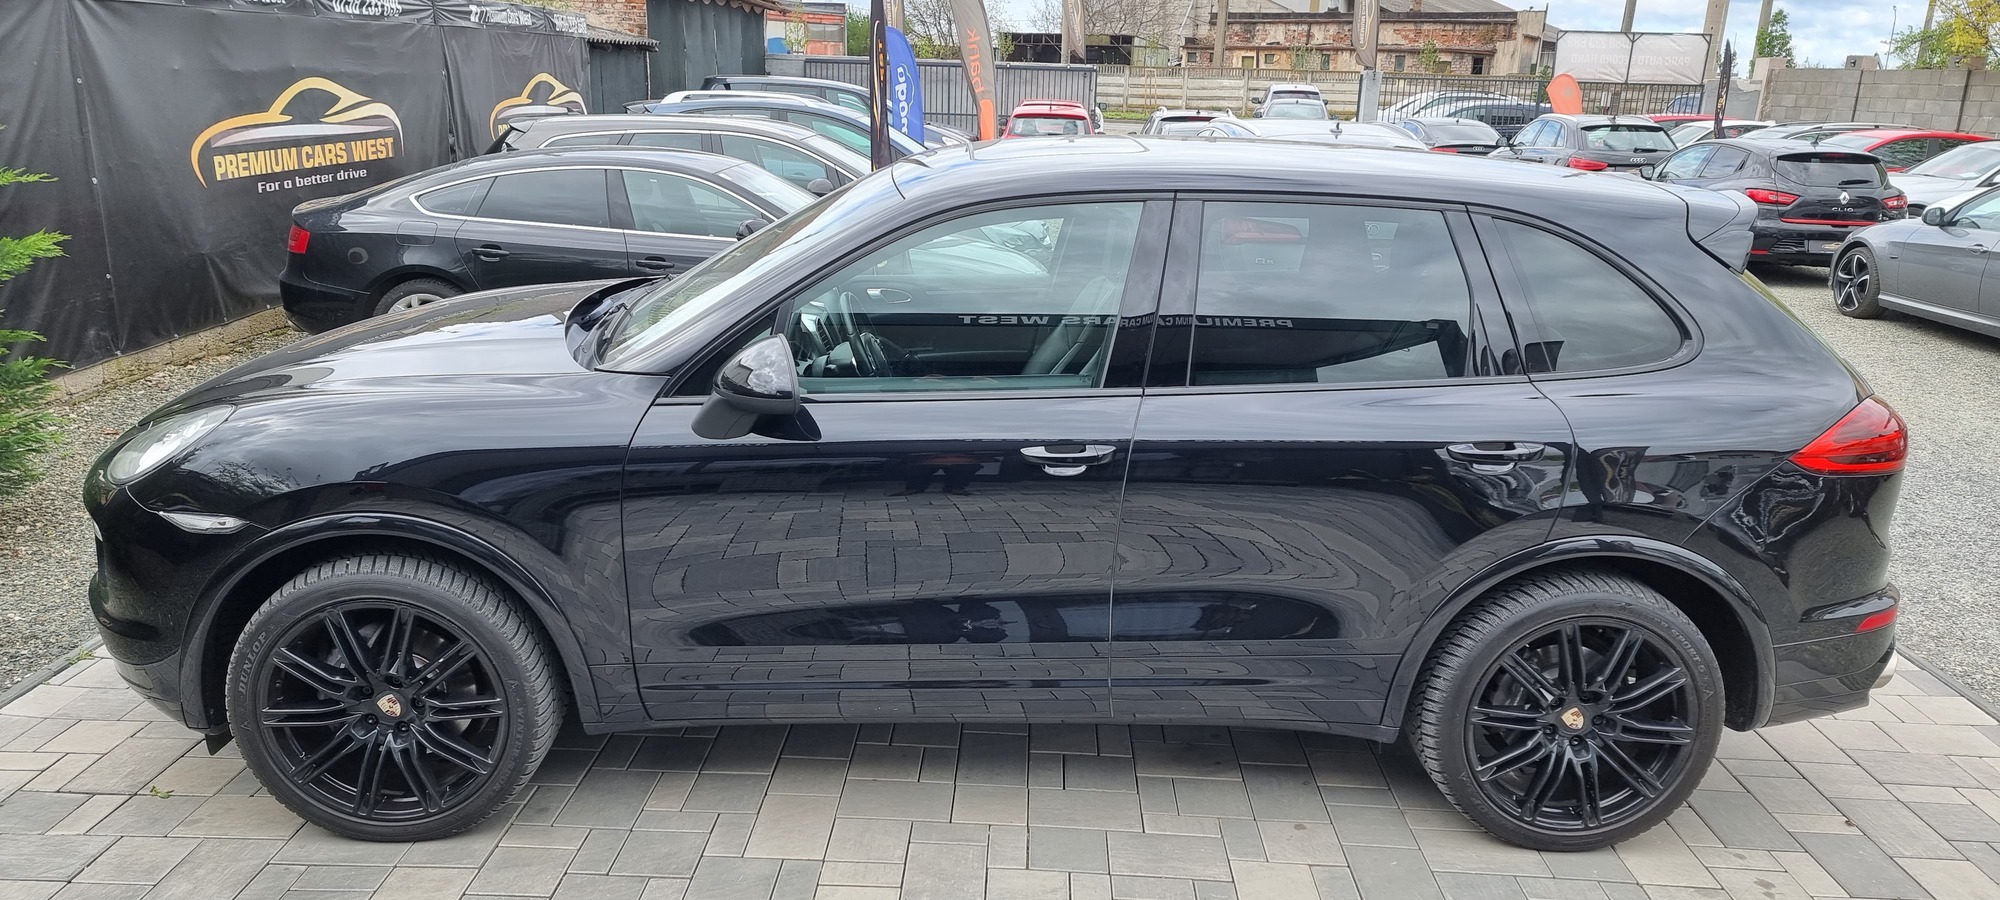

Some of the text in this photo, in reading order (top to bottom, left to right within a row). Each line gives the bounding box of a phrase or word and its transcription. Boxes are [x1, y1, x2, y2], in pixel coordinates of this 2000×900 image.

[213, 137, 395, 181] PREMIUM CARS WEST
[258, 168, 368, 193] For a better drive
[238, 631, 267, 695] DUNLOP
